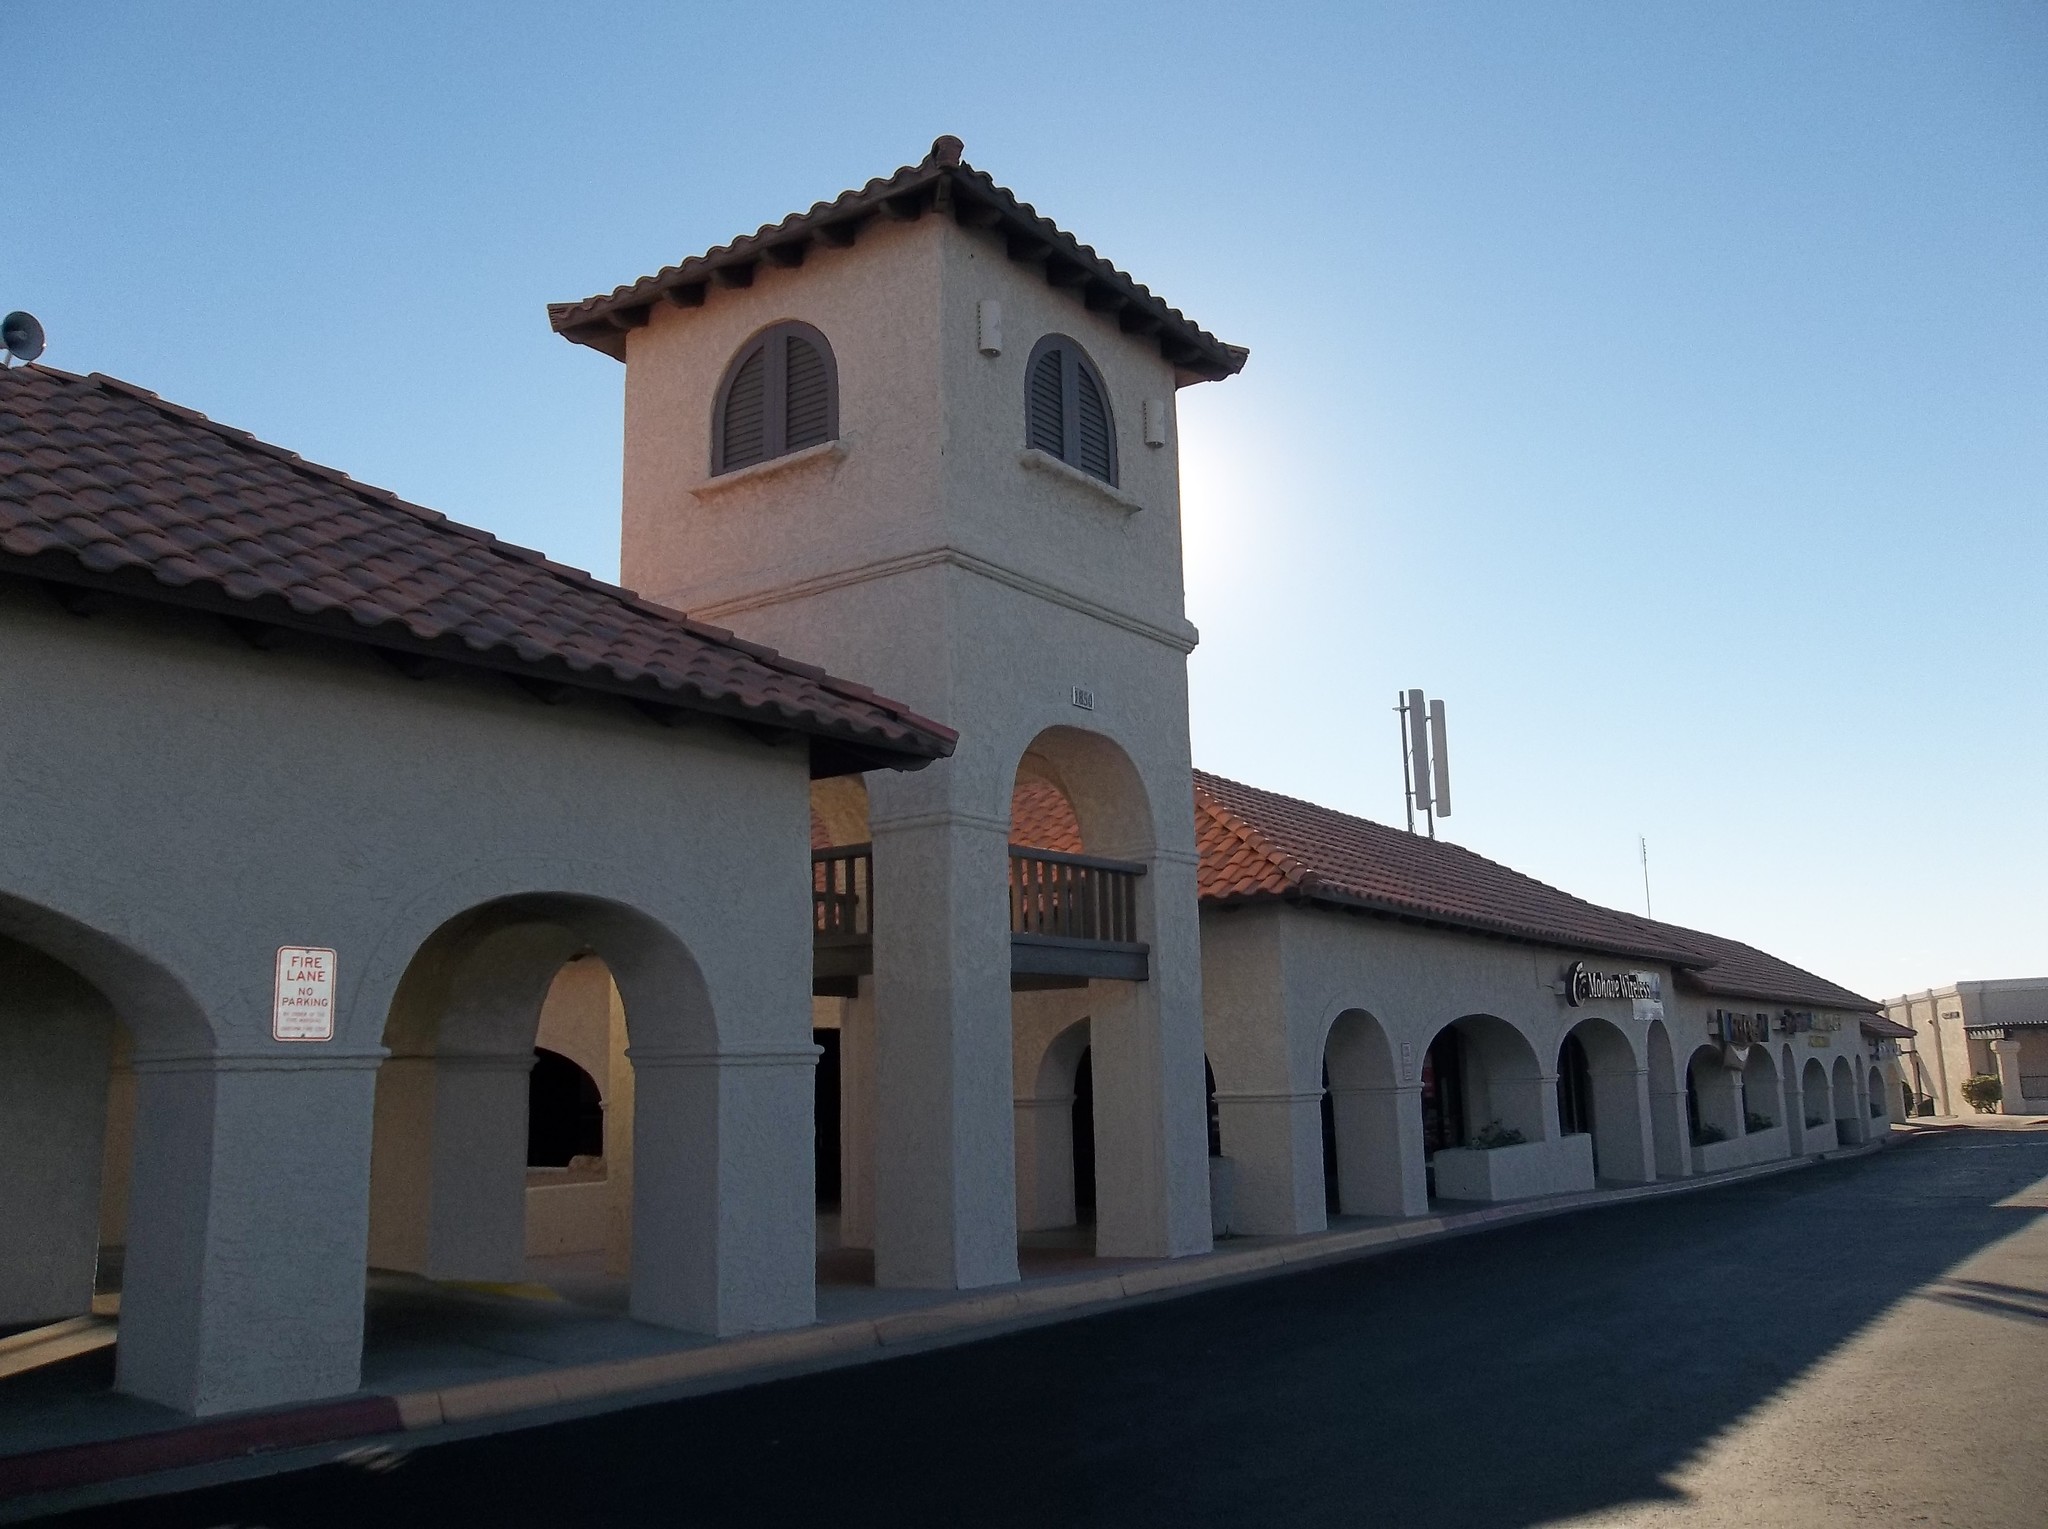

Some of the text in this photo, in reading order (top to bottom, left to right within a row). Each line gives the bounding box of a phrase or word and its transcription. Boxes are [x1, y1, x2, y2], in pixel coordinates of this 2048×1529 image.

[291, 956, 323, 968] FIRE
[286, 970, 326, 982] LANE
[298, 987, 314, 996] NO
[1619, 973, 1652, 999] Wireless
[282, 997, 328, 1007] PARKING
